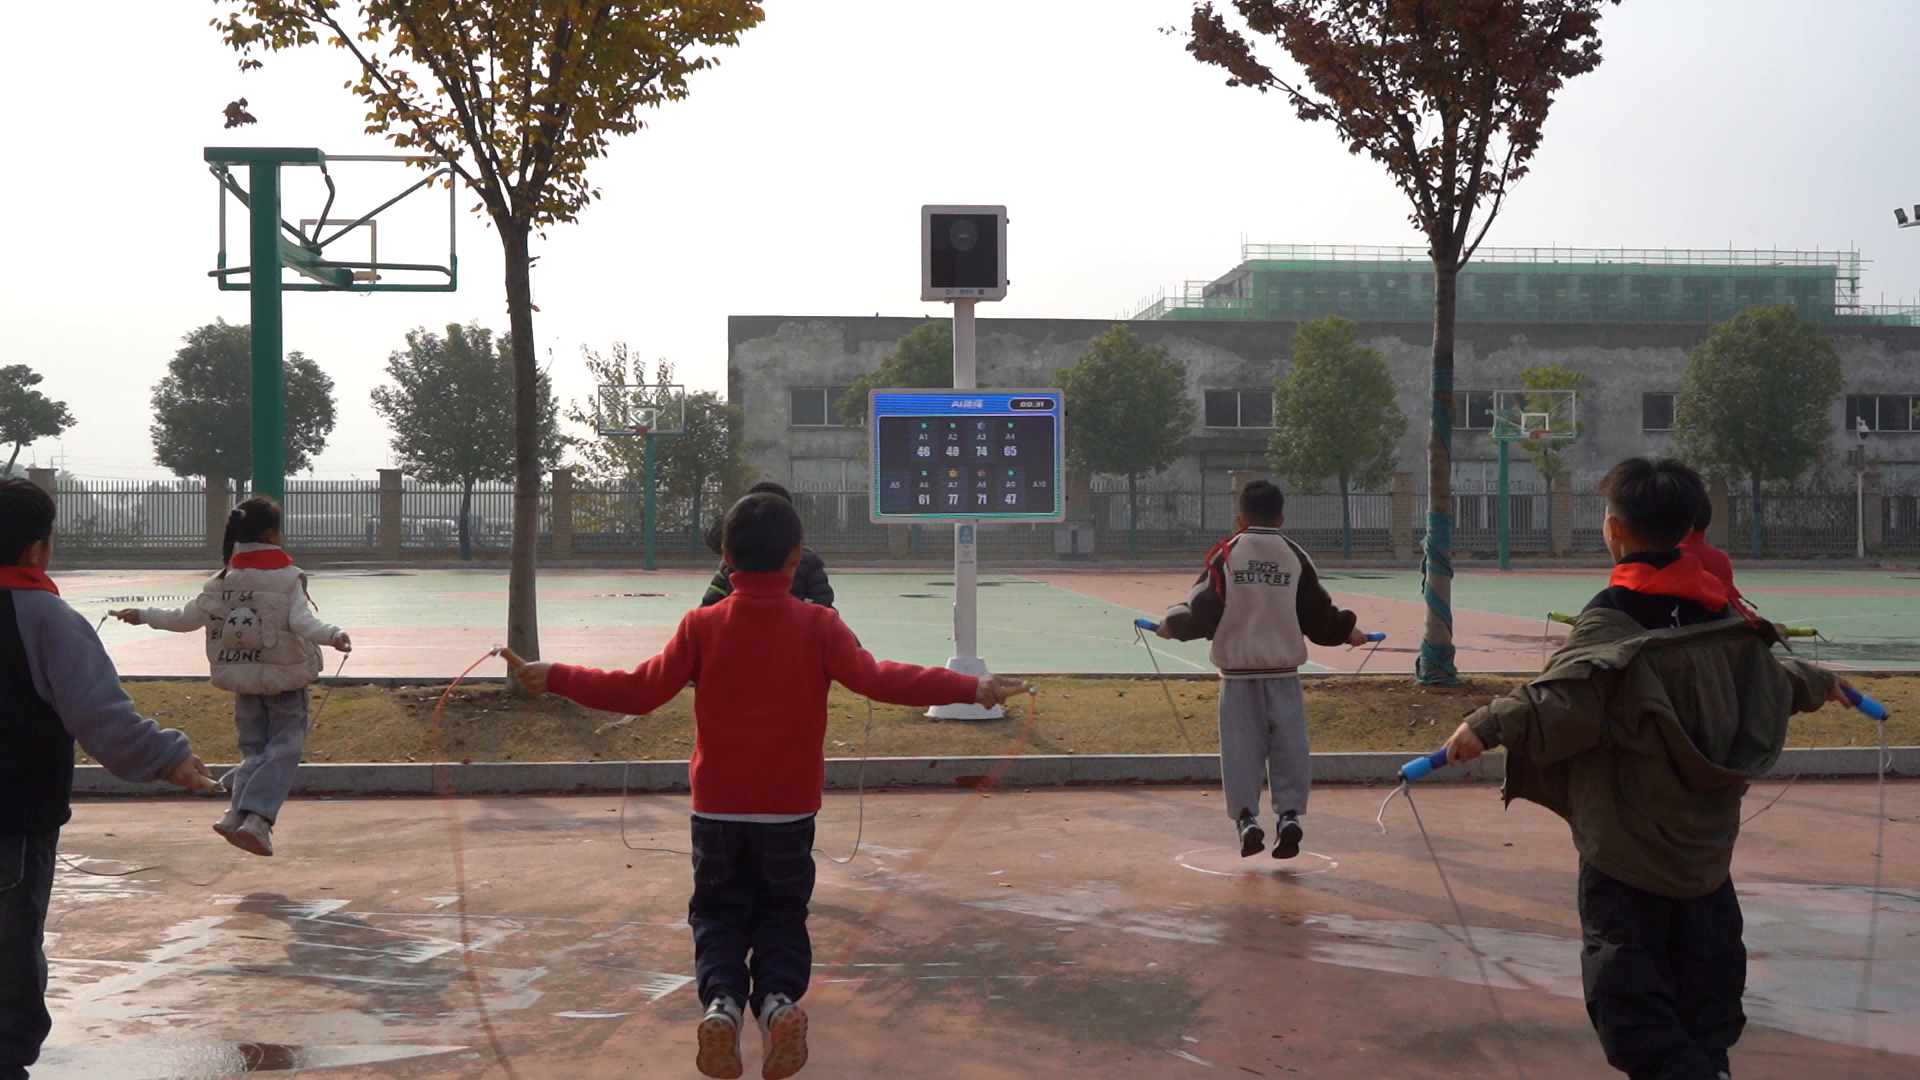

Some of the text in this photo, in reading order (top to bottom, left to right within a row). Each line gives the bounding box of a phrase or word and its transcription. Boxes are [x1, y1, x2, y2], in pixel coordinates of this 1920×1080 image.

[976, 446, 987, 457] 74
[948, 494, 958, 505] 77
[977, 494, 987, 505] 71
[1005, 494, 1017, 505] 47
[217, 649, 263, 662] ALONE
